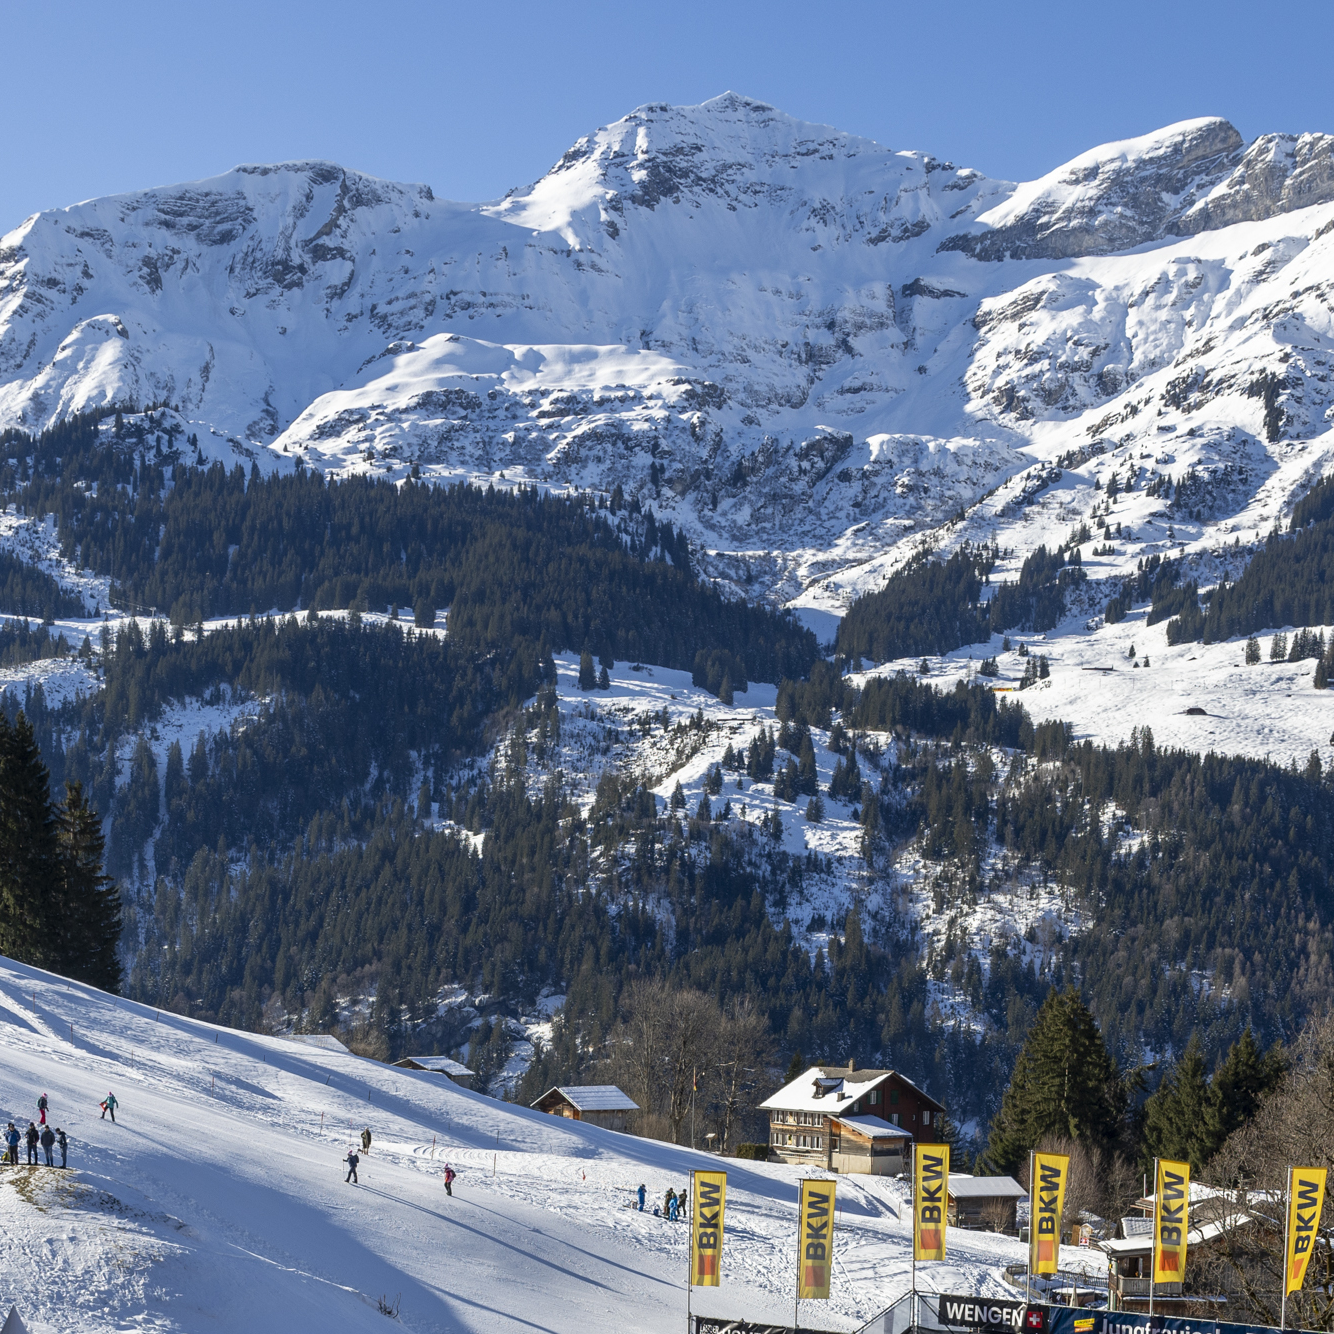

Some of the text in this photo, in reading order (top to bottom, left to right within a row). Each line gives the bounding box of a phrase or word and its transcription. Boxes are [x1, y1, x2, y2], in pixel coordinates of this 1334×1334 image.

[698, 1181, 720, 1250] BKW
[921, 1154, 944, 1224] BKW
[1038, 1164, 1061, 1235] BKW
[1160, 1170, 1185, 1246] BKW
[1294, 1179, 1319, 1253] BKW
[806, 1191, 829, 1261] BKW
[946, 1302, 1024, 1327] WENGEN
